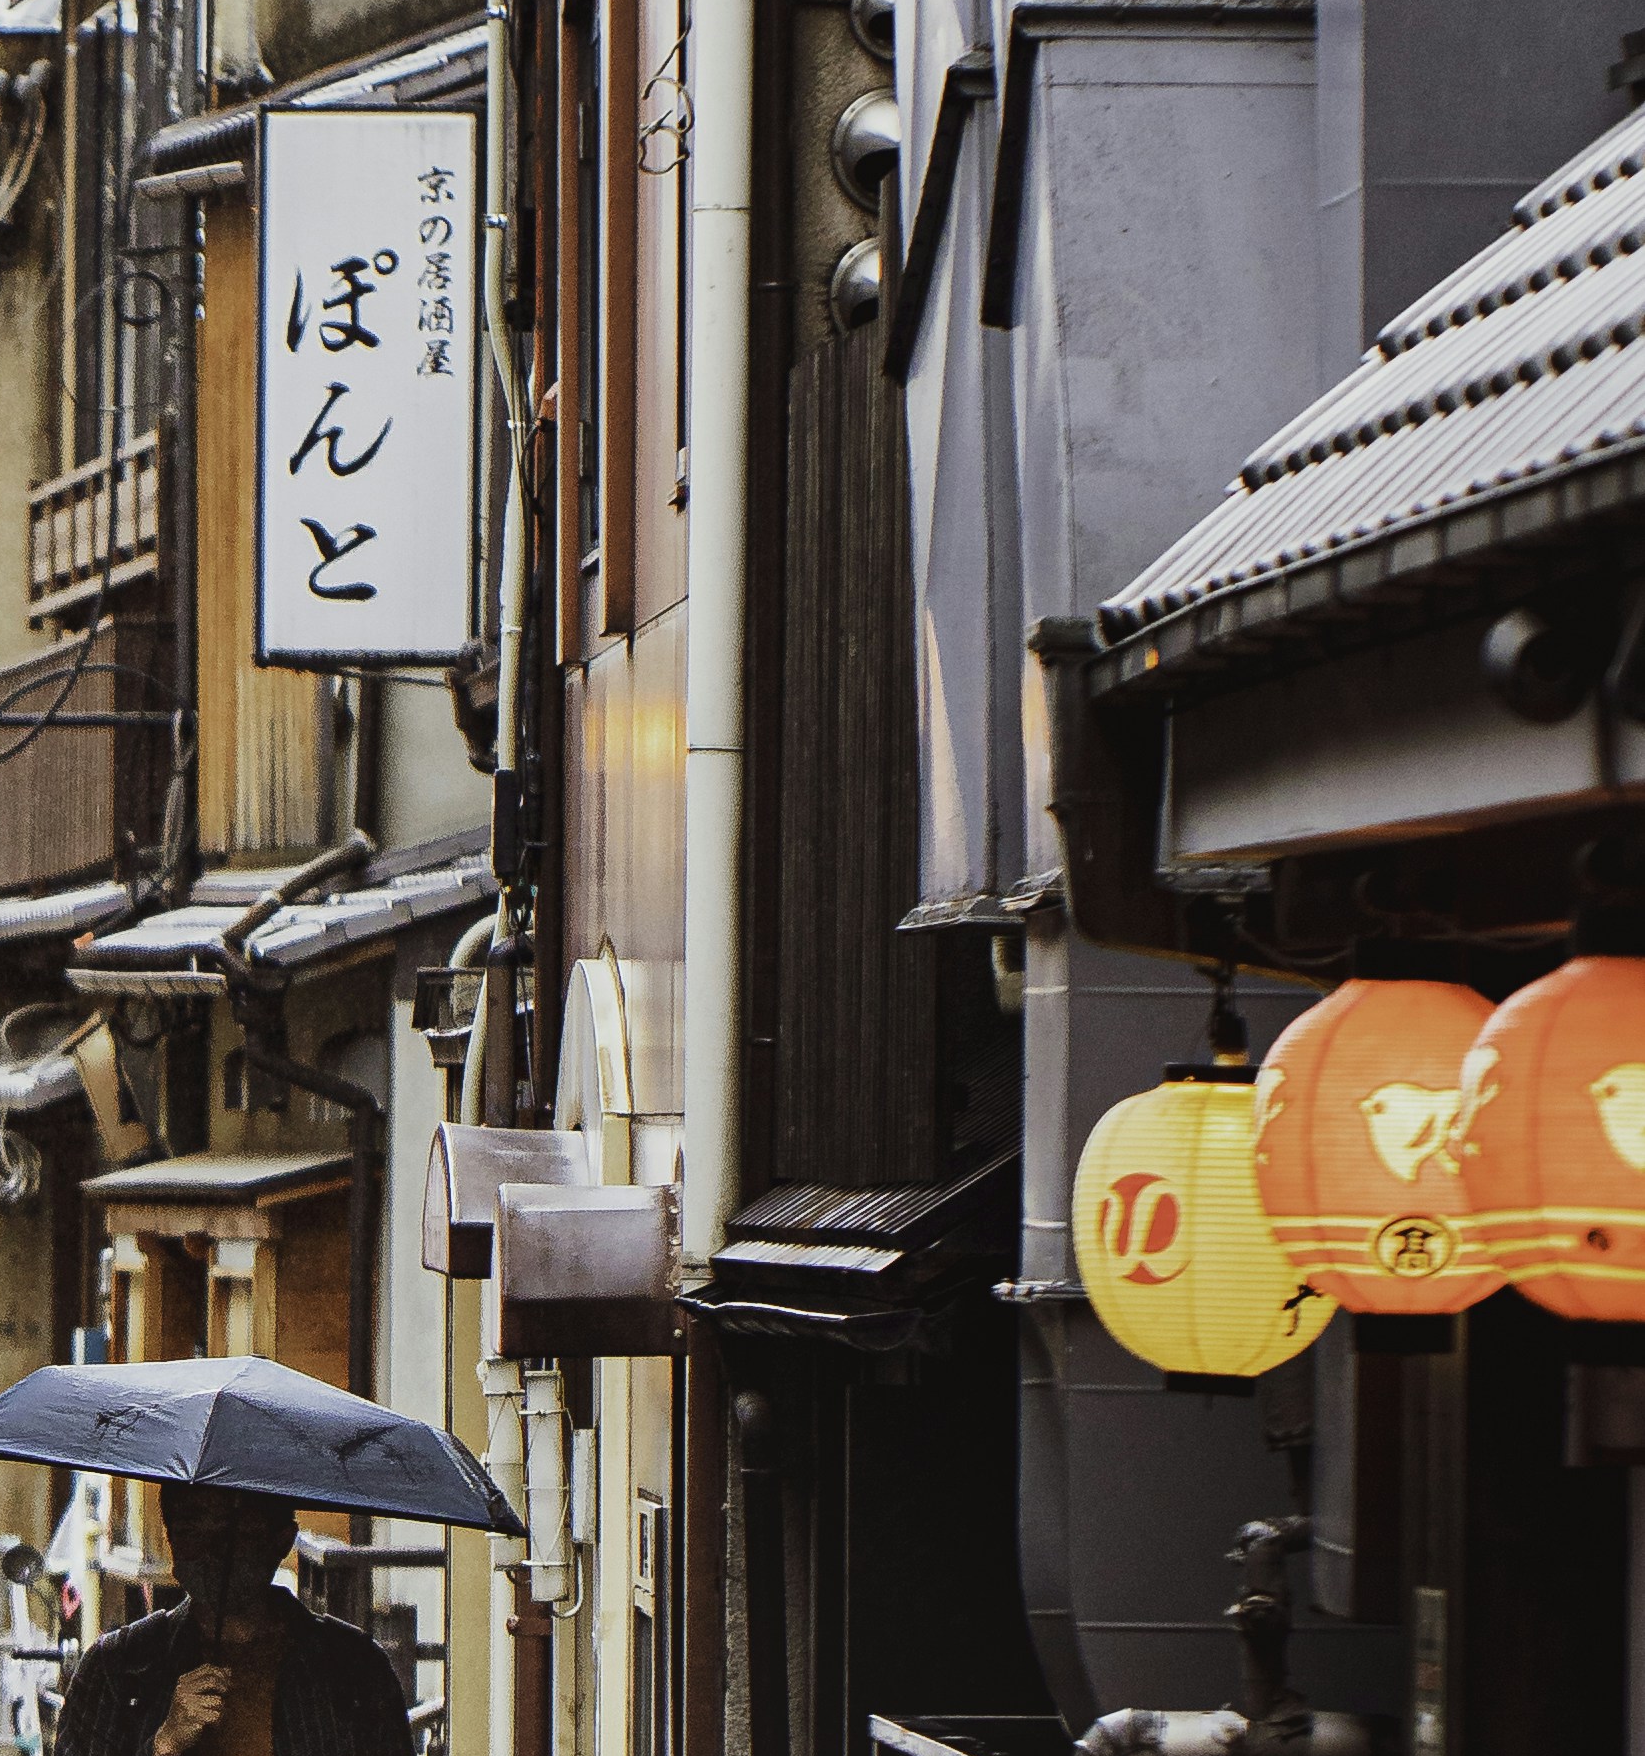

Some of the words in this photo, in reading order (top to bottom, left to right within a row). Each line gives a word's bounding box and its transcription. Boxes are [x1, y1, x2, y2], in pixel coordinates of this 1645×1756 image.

[416, 165, 455, 378] 京の居酒屋
[286, 248, 400, 602] ぽんと
